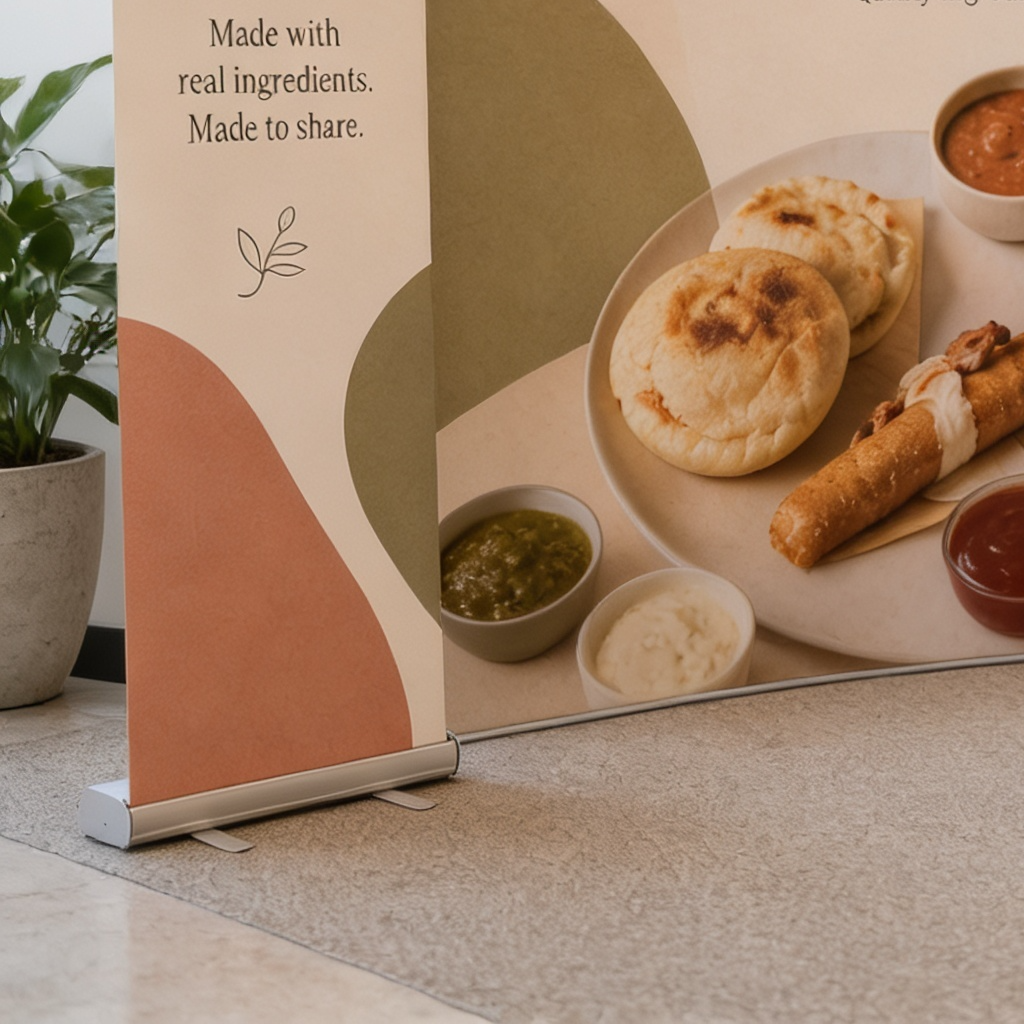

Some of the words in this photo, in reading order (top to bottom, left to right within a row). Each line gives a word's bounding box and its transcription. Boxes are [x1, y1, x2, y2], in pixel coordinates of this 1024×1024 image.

[208, 17, 279, 48] Made
[285, 17, 341, 47] with
[177, 64, 225, 95] real
[234, 64, 373, 102] ingredients.
[187, 110, 259, 144] Made
[264, 116, 289, 142] to
[296, 111, 364, 141] share.
